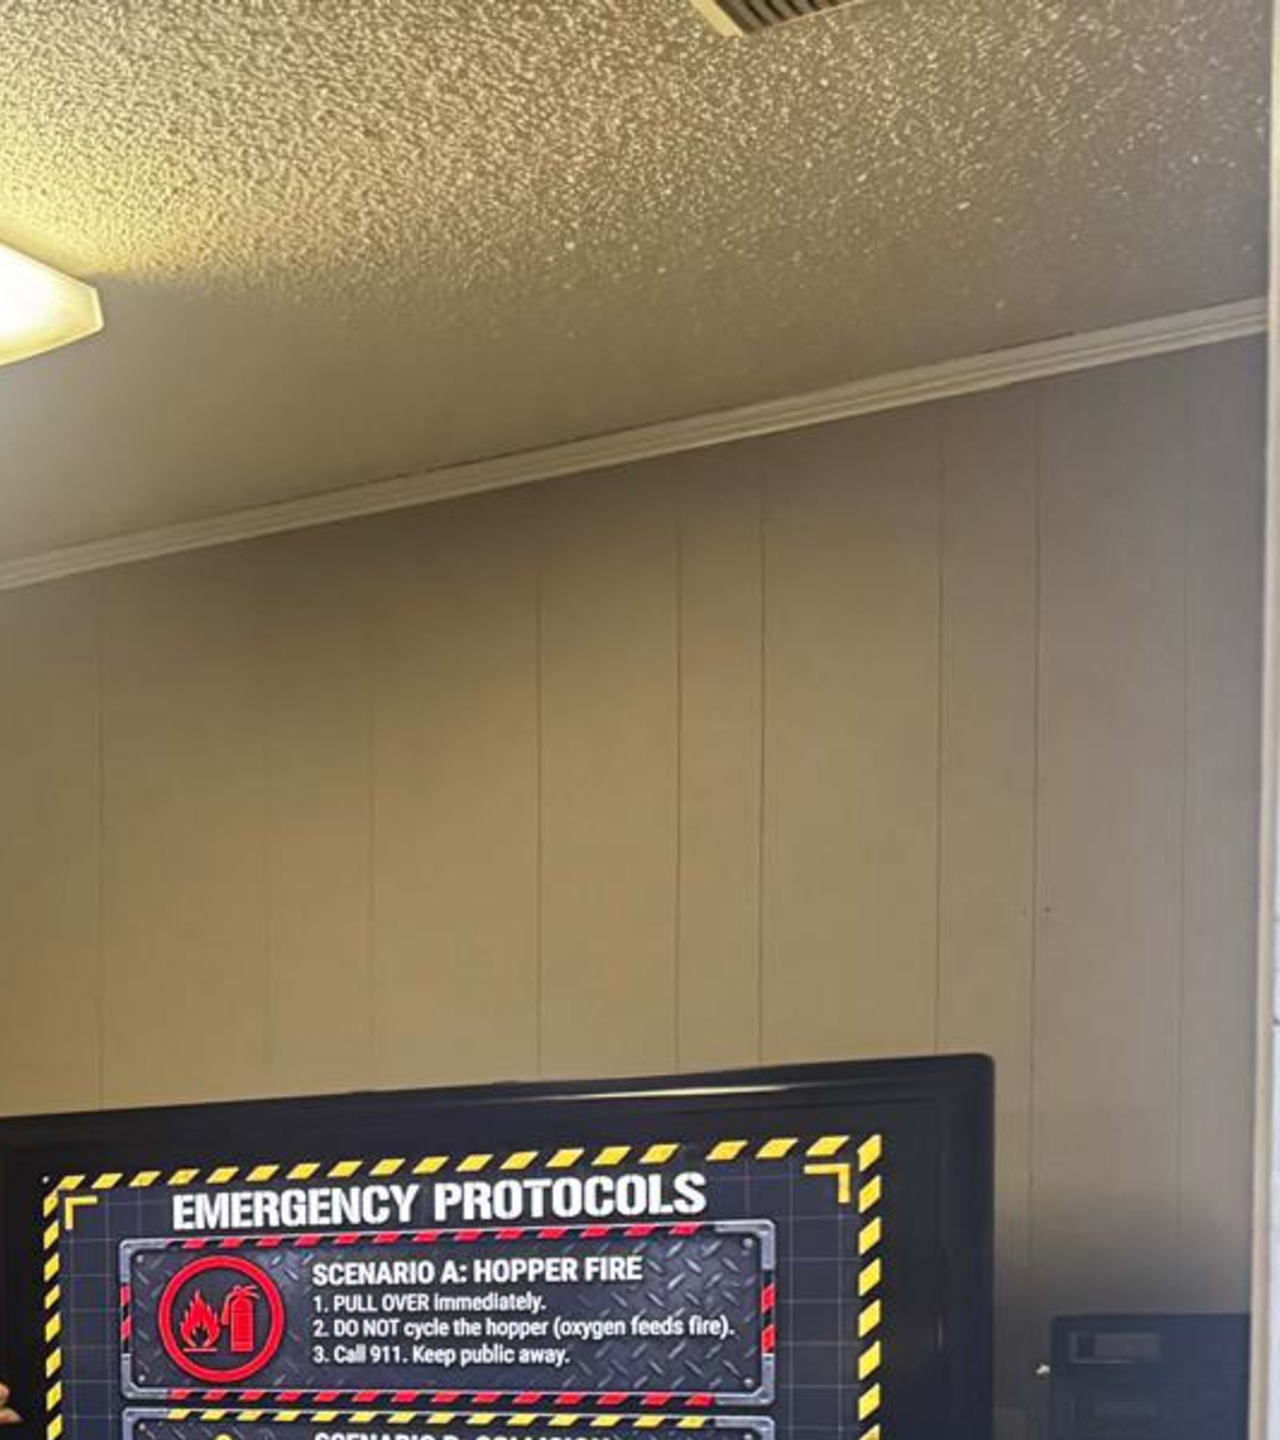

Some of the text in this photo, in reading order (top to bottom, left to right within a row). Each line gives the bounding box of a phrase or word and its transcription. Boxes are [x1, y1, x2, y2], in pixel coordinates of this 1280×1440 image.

[173, 1172, 707, 1230] EMERGENCY PROTOCOLS
[312, 1256, 643, 1286] SCENARIO A: HOPPER FIRE
[313, 1291, 546, 1314] 1. PULL OVER immediately.
[312, 1314, 735, 1340] 2. DO NOT cycle the hopper (oxygen feeds fire).
[313, 1342, 570, 1368] 3. Call 911. Keep public away.
